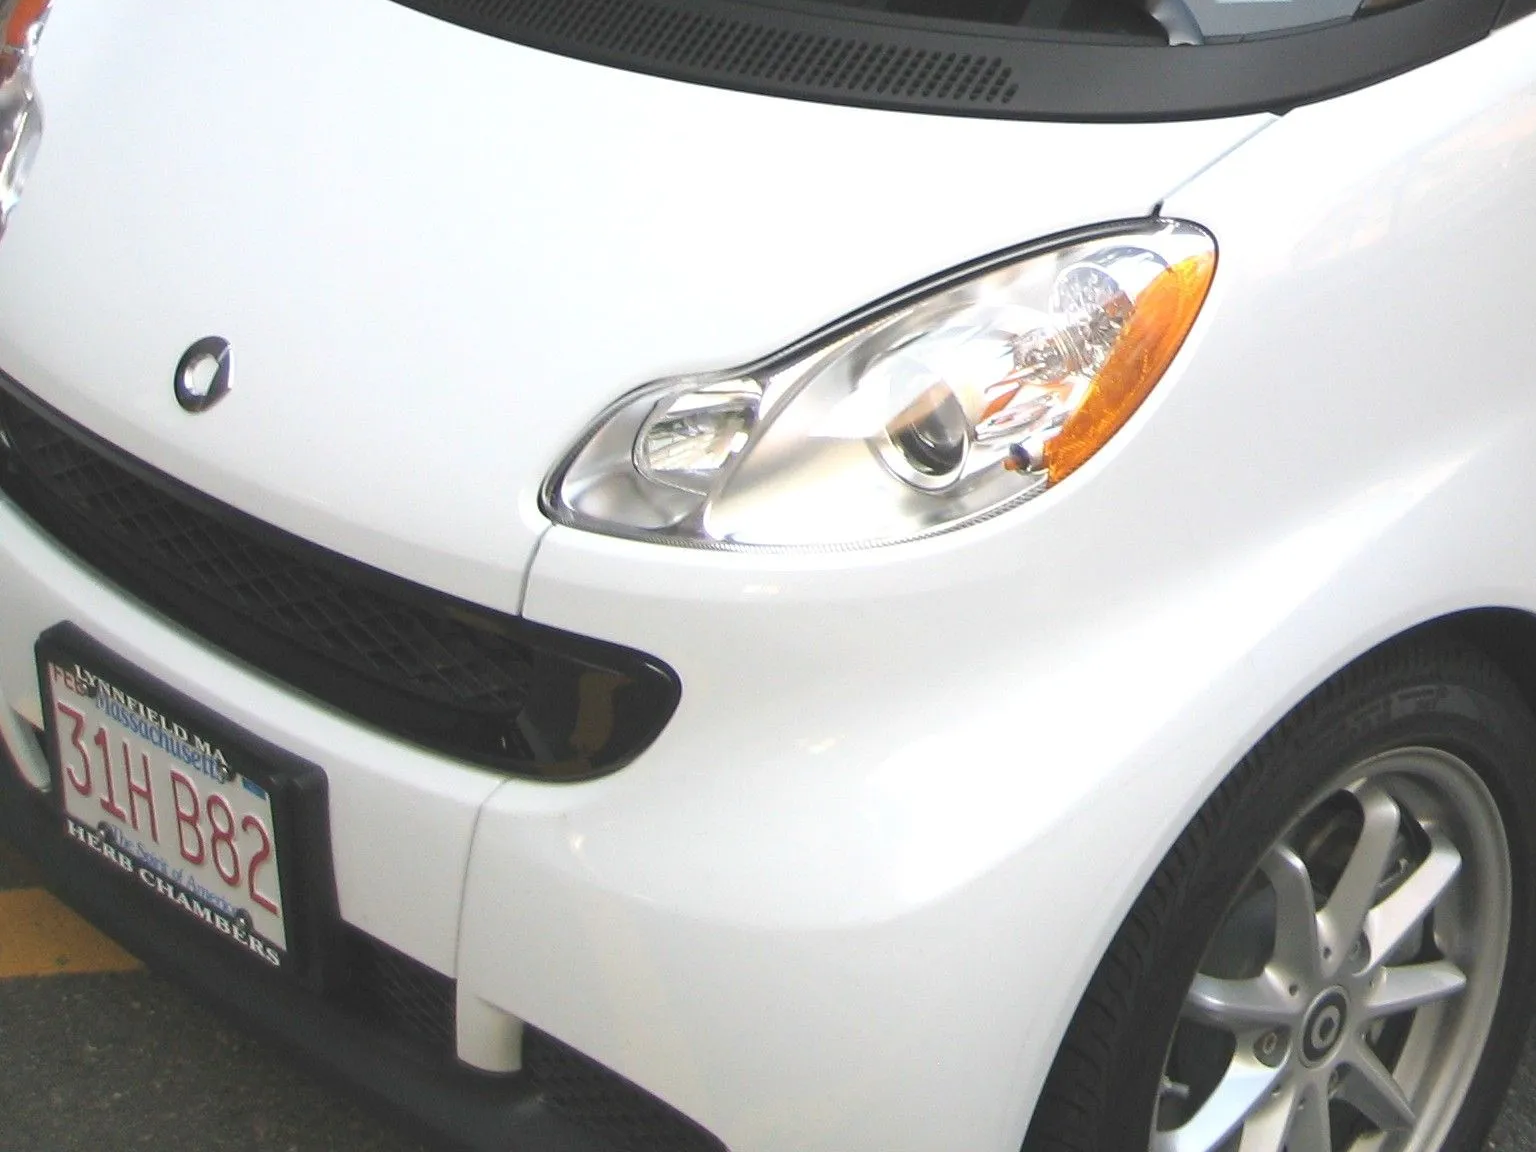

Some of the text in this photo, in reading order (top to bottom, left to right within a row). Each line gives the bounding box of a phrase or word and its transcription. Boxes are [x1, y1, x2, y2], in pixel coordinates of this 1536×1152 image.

[74, 663, 229, 769] LYNNFIELD MA
[56, 700, 280, 917] 31H B82
[66, 820, 280, 967] HERB CHAMBERS
